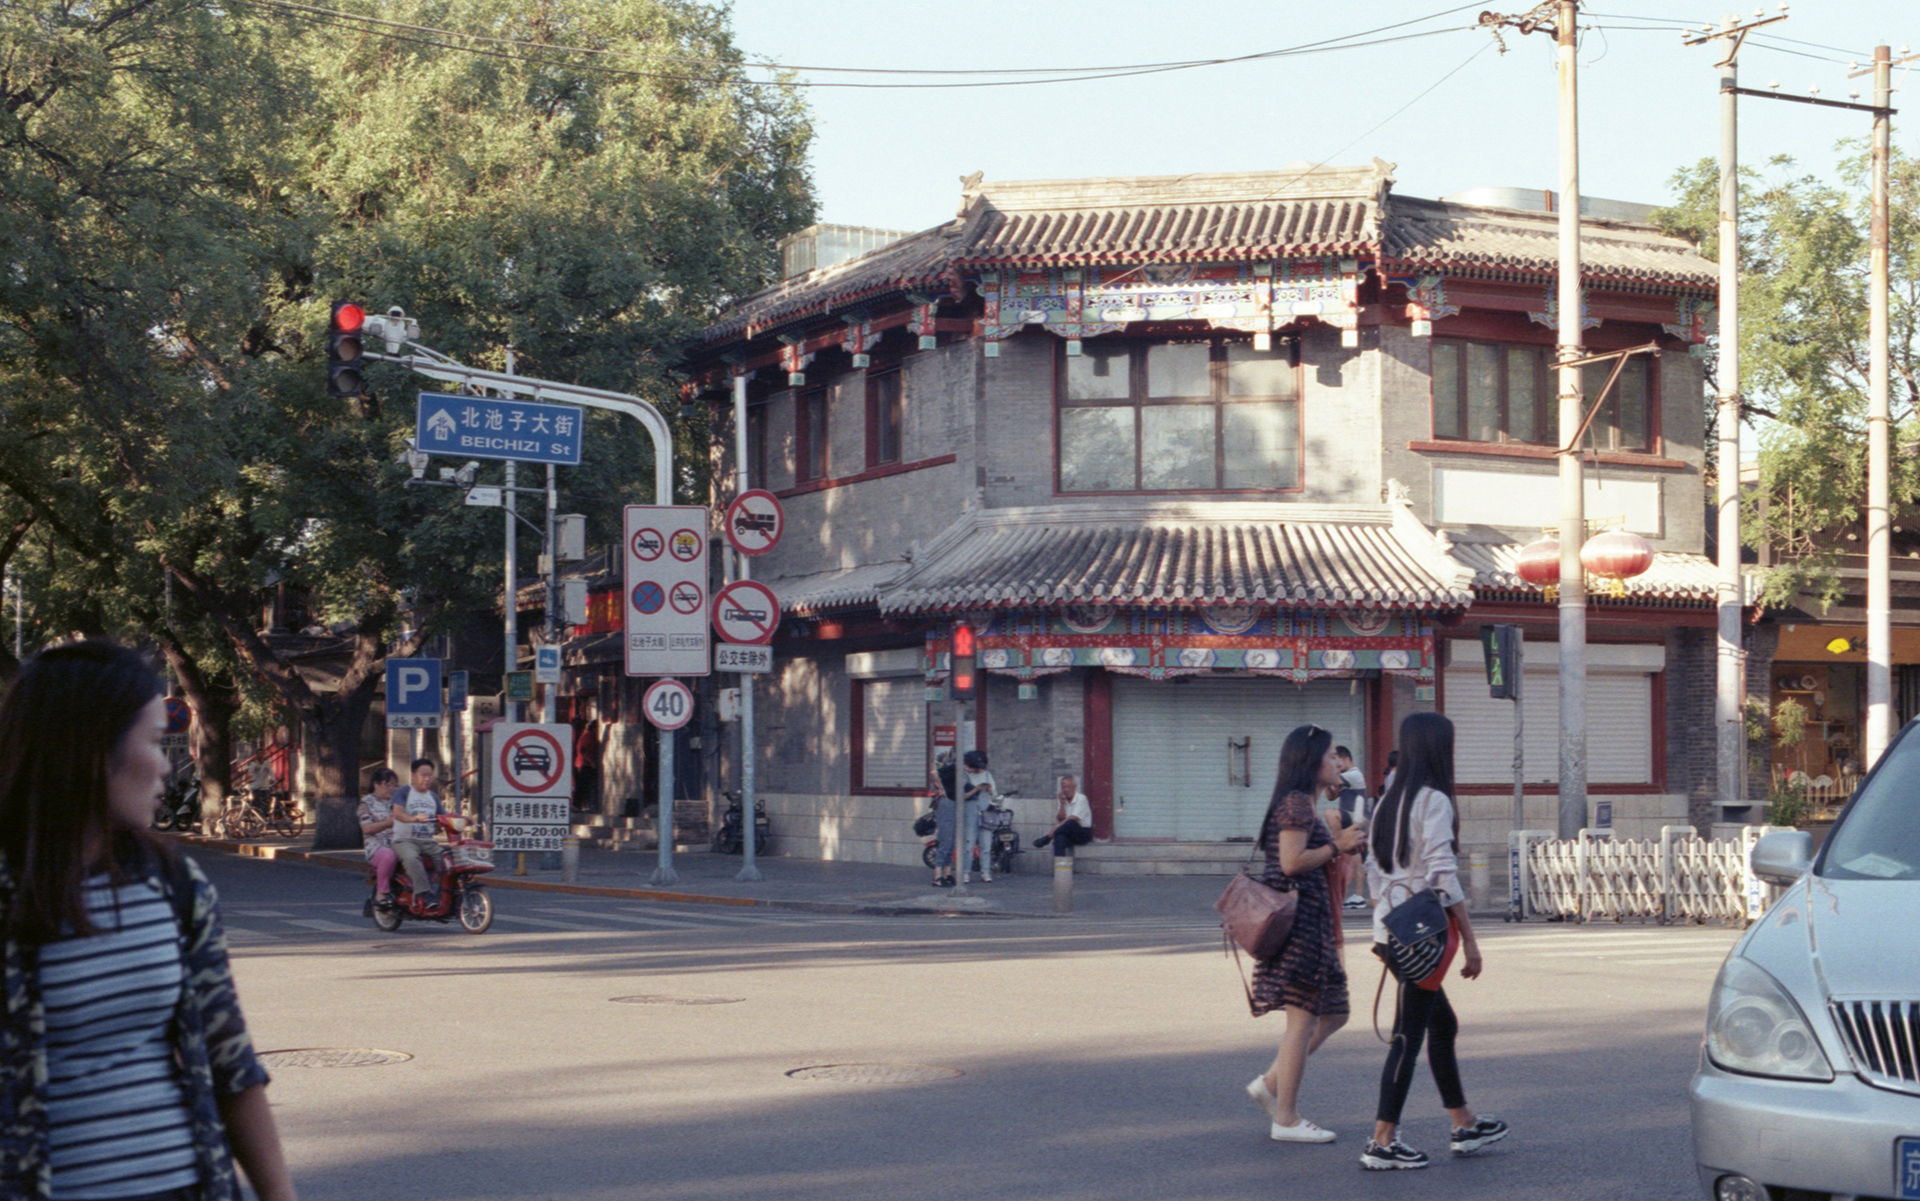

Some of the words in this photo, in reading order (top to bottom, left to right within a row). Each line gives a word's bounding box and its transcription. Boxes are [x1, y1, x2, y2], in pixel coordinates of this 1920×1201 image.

[436, 416, 448, 427] 北
[461, 406, 574, 437] 北池子大街
[437, 430, 446, 438] N
[461, 435, 540, 453] BEICHIZI
[551, 442, 571, 456] St
[719, 650, 768, 667] 公交车除外
[399, 667, 430, 704] P
[653, 691, 684, 717] 40
